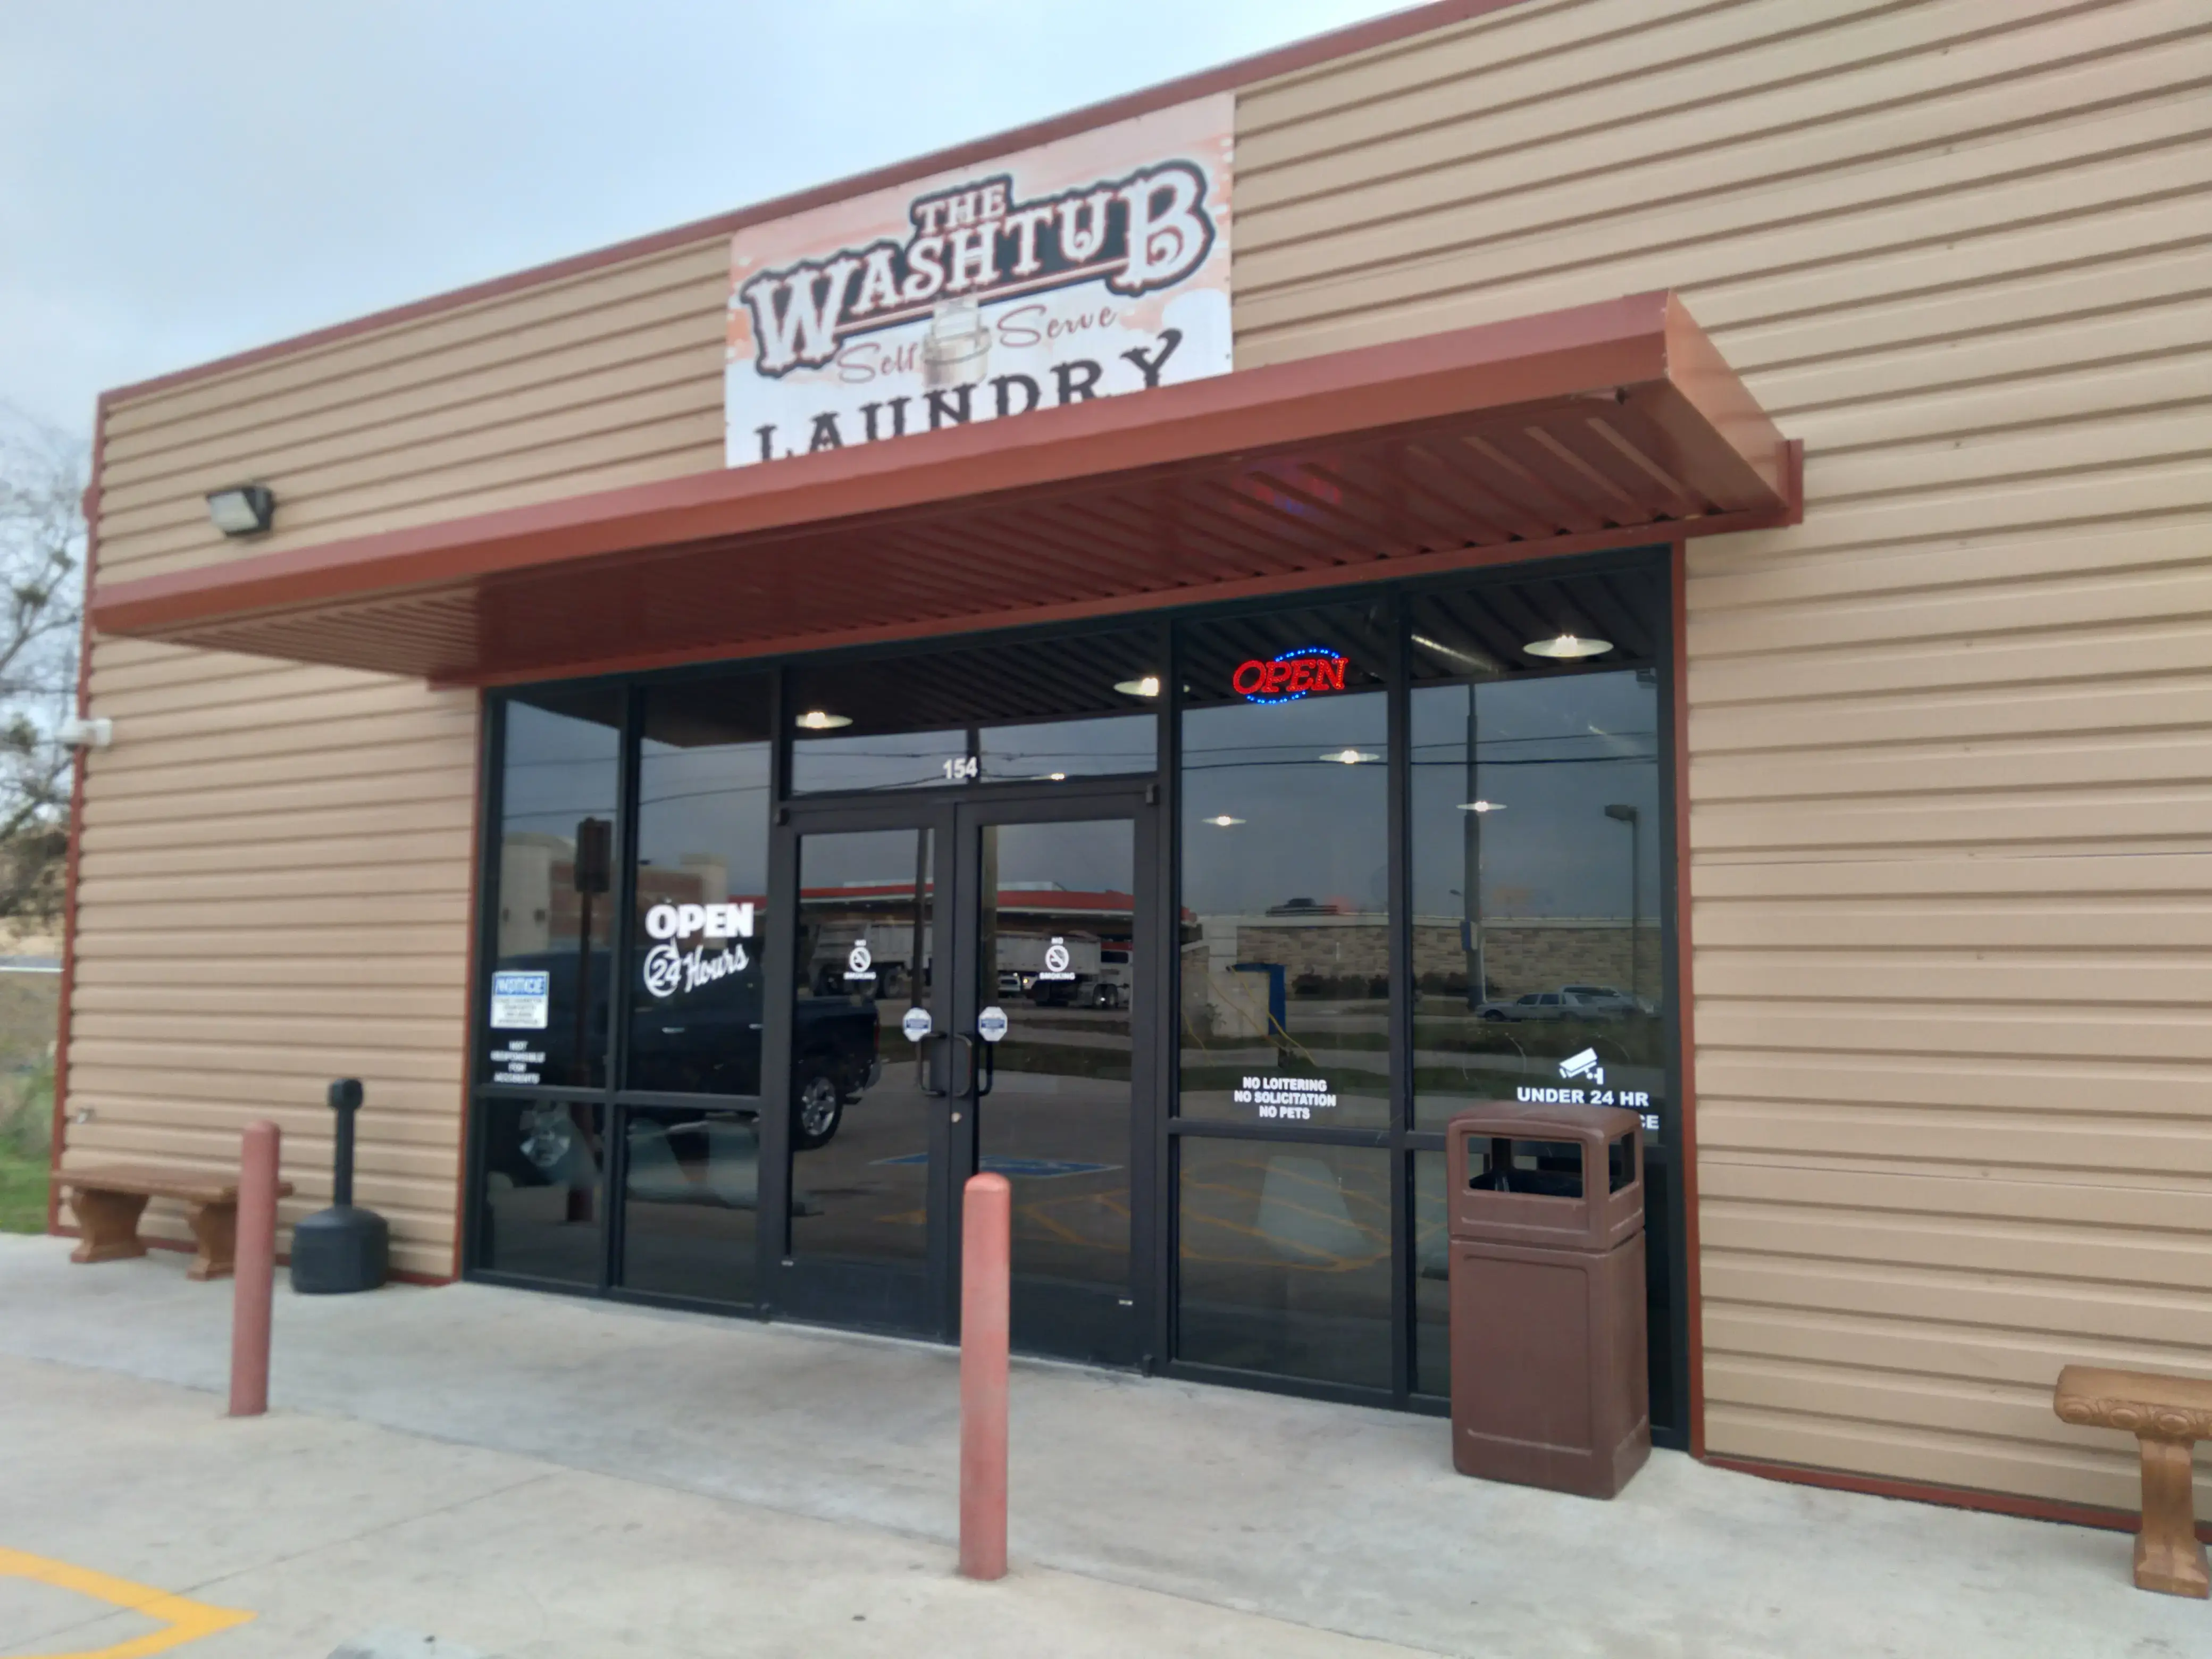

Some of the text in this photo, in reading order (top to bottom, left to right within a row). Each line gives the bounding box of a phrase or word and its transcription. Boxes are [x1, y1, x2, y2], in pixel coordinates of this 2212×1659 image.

[912, 180, 1008, 239] THE
[743, 162, 1212, 375] WASHTUB
[835, 304, 1120, 384] Self Serve
[1233, 657, 1348, 696] OPEN
[943, 756, 978, 780] 154
[645, 902, 754, 940] OPEN
[647, 944, 749, 993] 24 Hours
[1234, 1090, 1337, 1107] NO SOLICITATION
[1243, 1076, 1328, 1092] NO LOITERING
[1516, 1087, 1649, 1107] UNDER 24 HR
[1259, 1105, 1311, 1120] NO PETS
